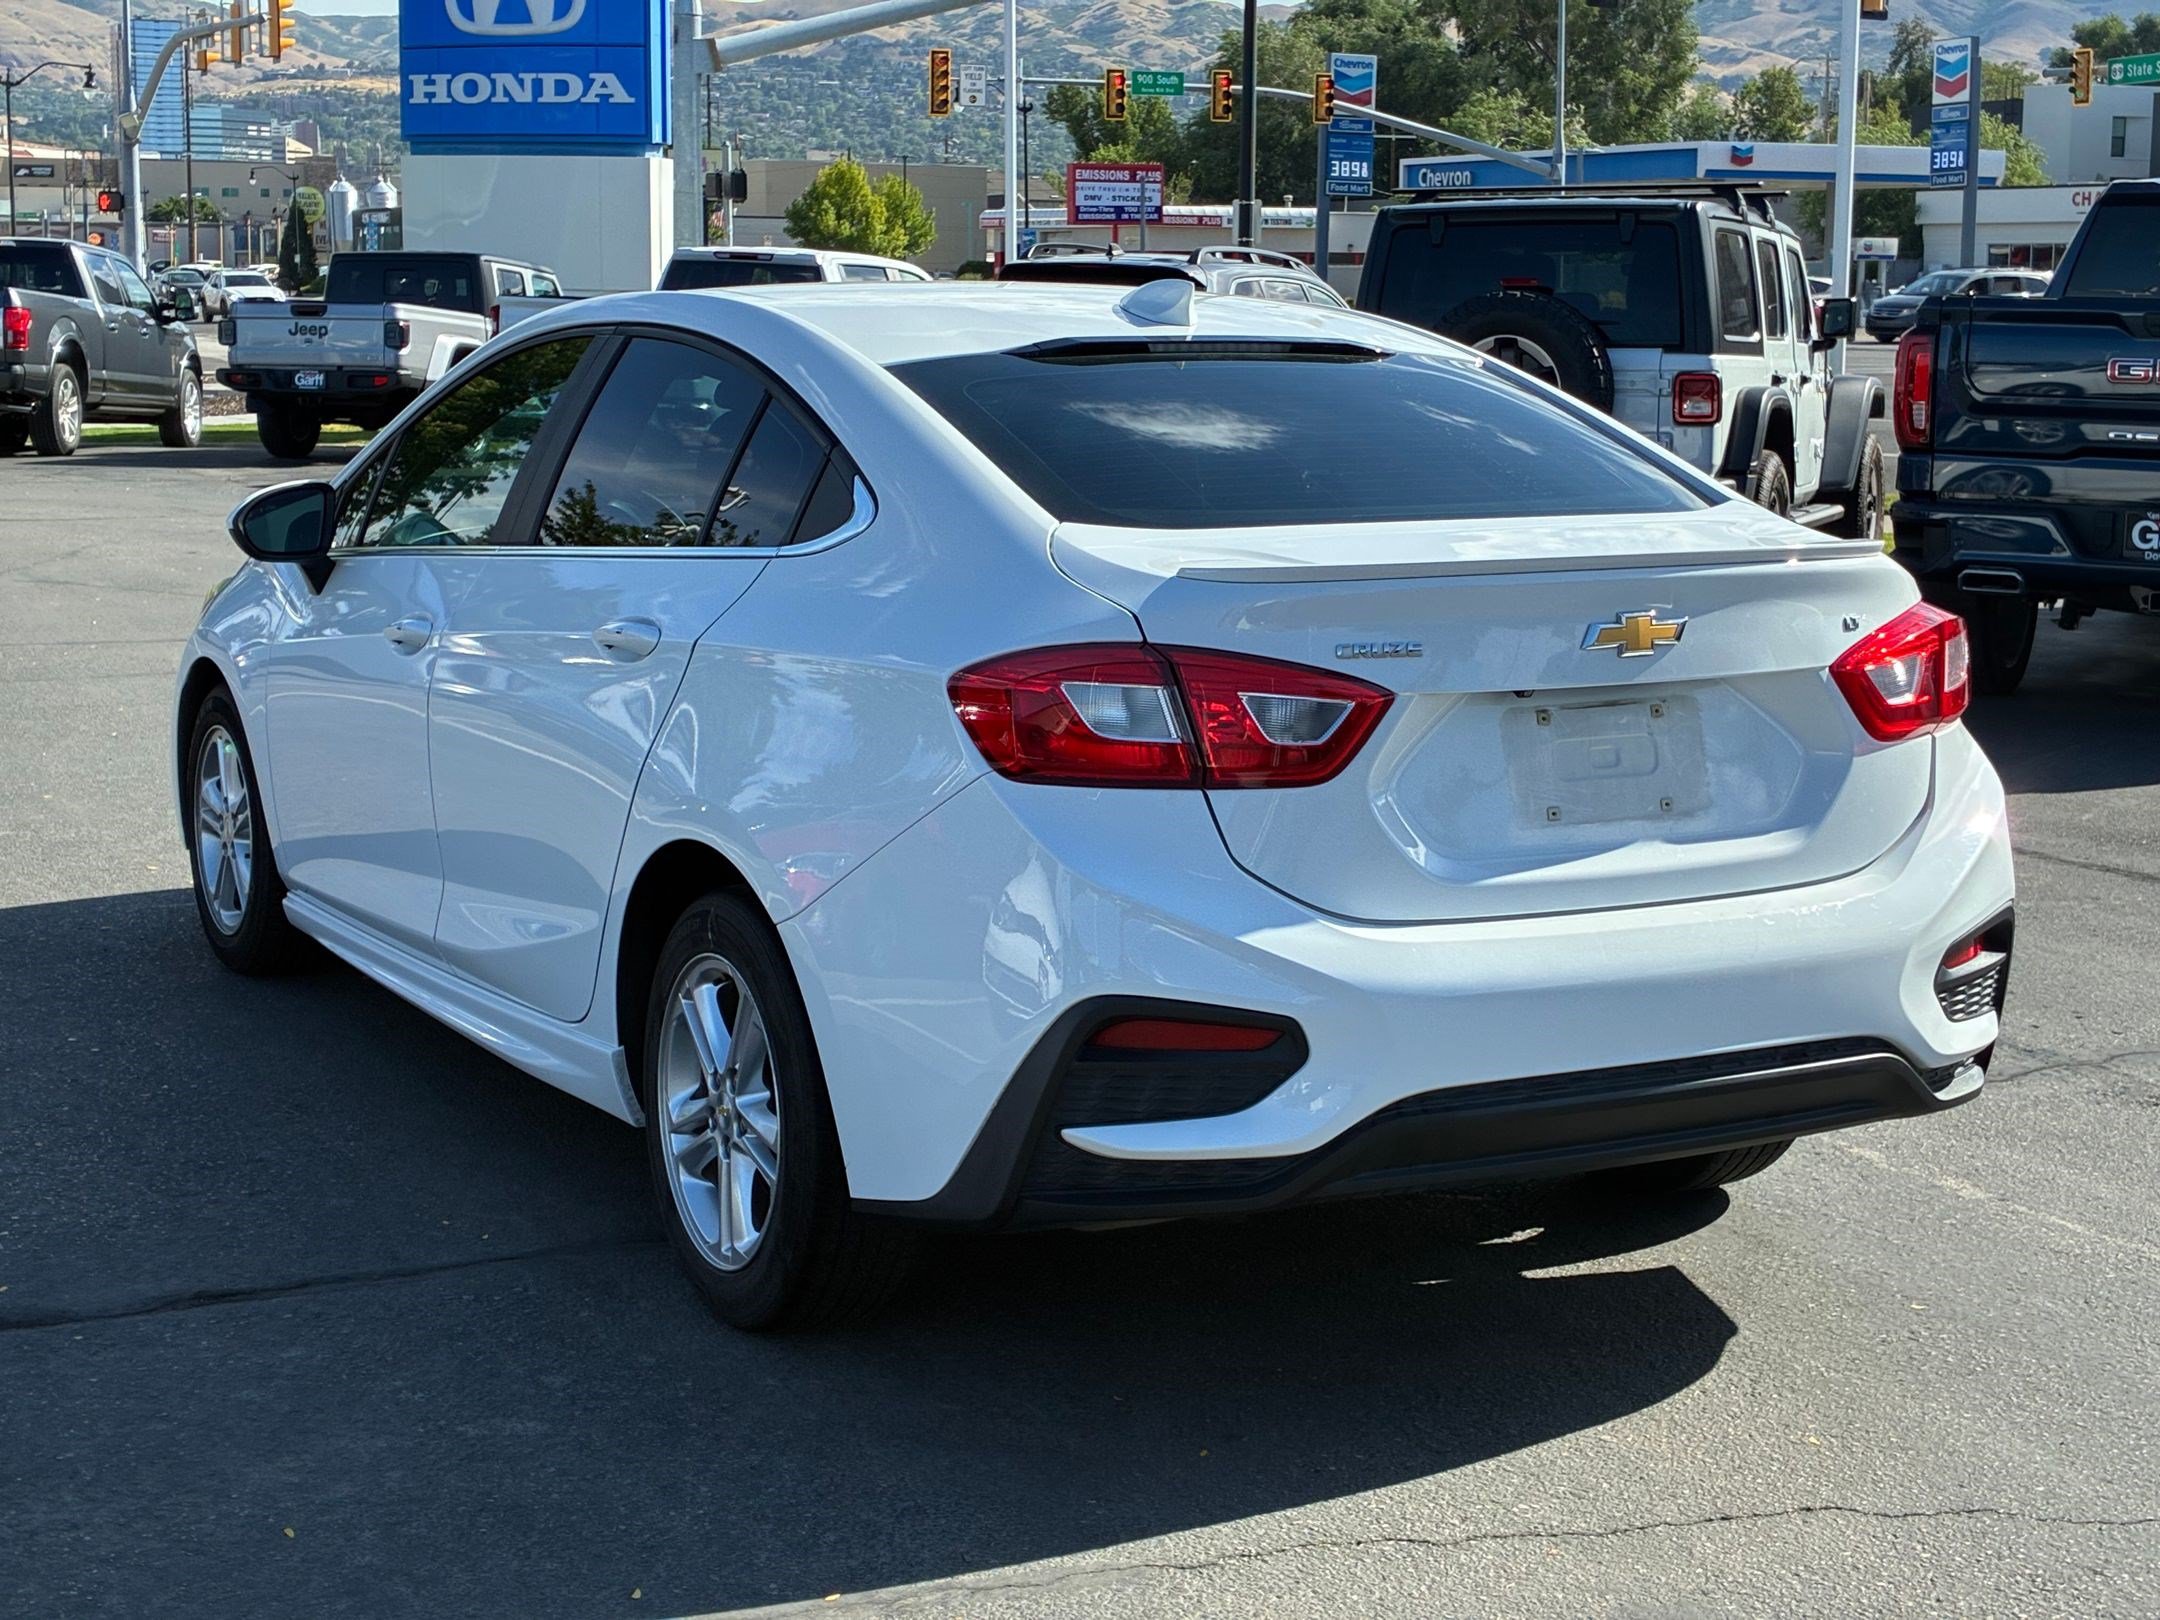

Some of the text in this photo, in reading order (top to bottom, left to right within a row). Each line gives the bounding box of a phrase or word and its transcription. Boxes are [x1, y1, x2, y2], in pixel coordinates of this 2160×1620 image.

[1935, 44, 1969, 56] Chevron
[1333, 57, 1374, 70] Chevron
[964, 72, 982, 80] YIELD
[2127, 63, 2153, 78] State
[1136, 74, 1179, 84] 900 South
[408, 72, 636, 104] HONDA
[1075, 169, 1130, 180] EMISSIONS
[1418, 167, 1472, 187] Chevron
[1932, 173, 1964, 185] Food Mart
[1330, 183, 1369, 193] Food Mart
[1083, 194, 1102, 202] DMV
[1111, 195, 1153, 203] STICKES
[1163, 216, 1198, 225] MISSIONS
[1202, 216, 1222, 225] PLUS
[288, 321, 328, 339] Jeep
[295, 373, 325, 387] Garff
[2144, 551, 2160, 561] Do
[1335, 642, 1424, 660] CRUZE
